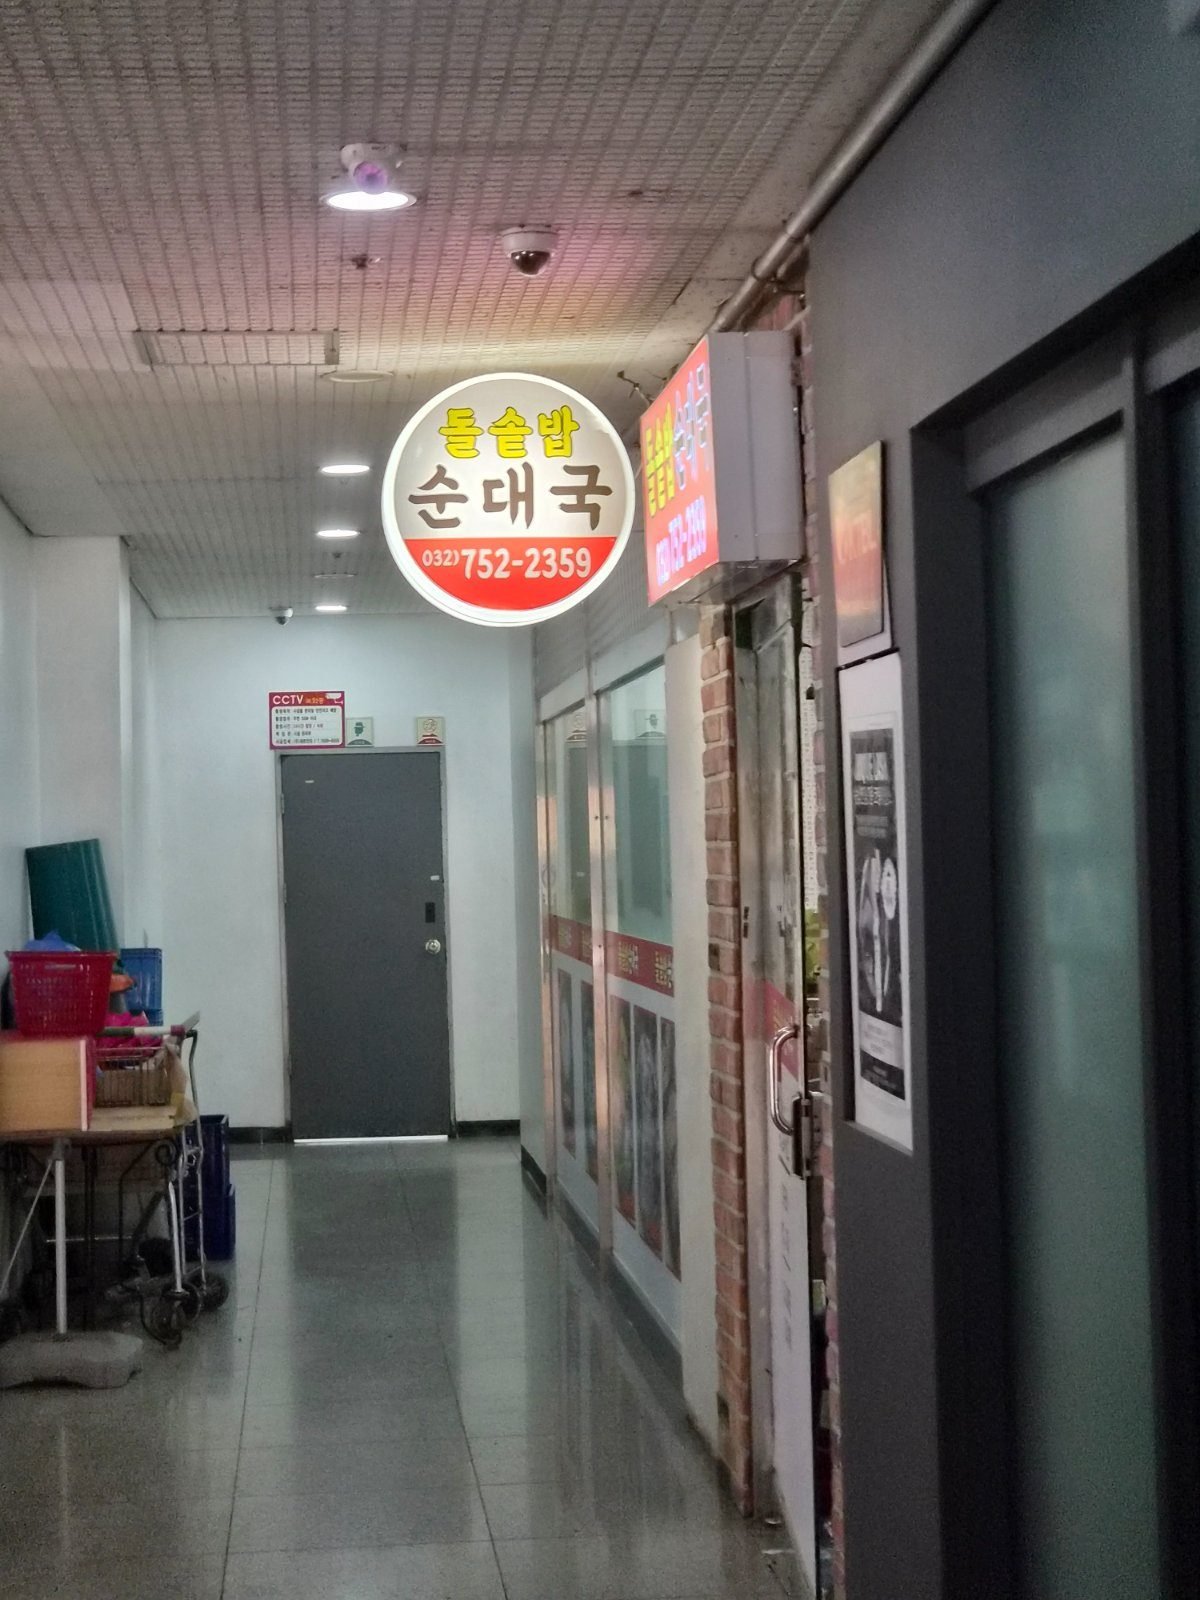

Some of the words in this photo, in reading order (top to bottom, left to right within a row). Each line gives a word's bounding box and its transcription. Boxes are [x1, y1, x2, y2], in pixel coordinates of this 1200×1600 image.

[438, 405, 581, 458] 돌솥밥
[408, 461, 613, 531] 순대국
[272, 694, 304, 705] CCTV
